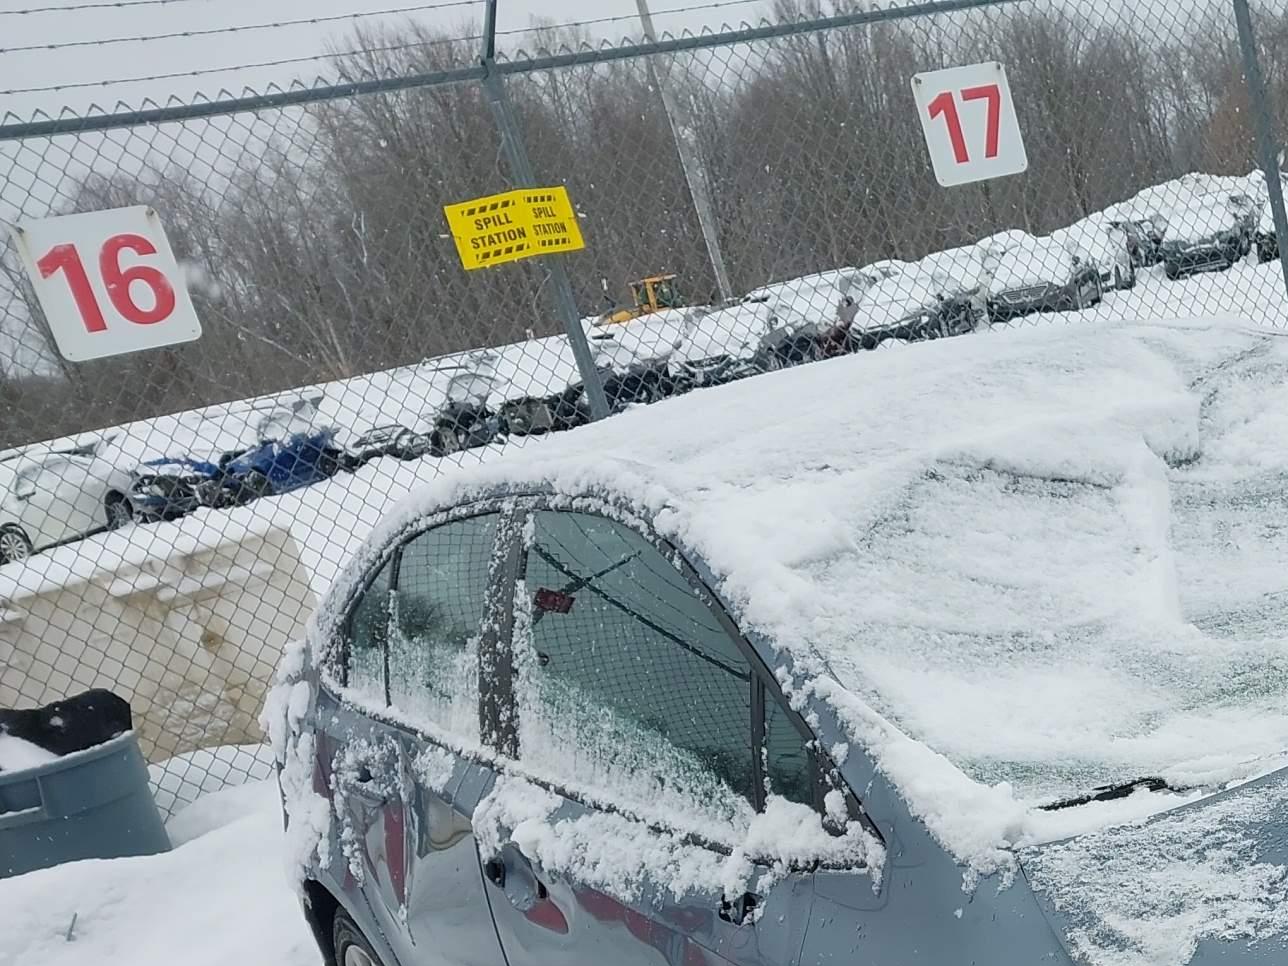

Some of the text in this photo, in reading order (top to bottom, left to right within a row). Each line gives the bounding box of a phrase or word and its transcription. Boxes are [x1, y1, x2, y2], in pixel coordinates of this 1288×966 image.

[927, 84, 1001, 164] 17
[474, 212, 513, 231] SPILL
[532, 206, 556, 219] SPILL
[470, 226, 527, 249] STATION
[532, 222, 567, 236] STATION
[36, 233, 176, 333] 16
